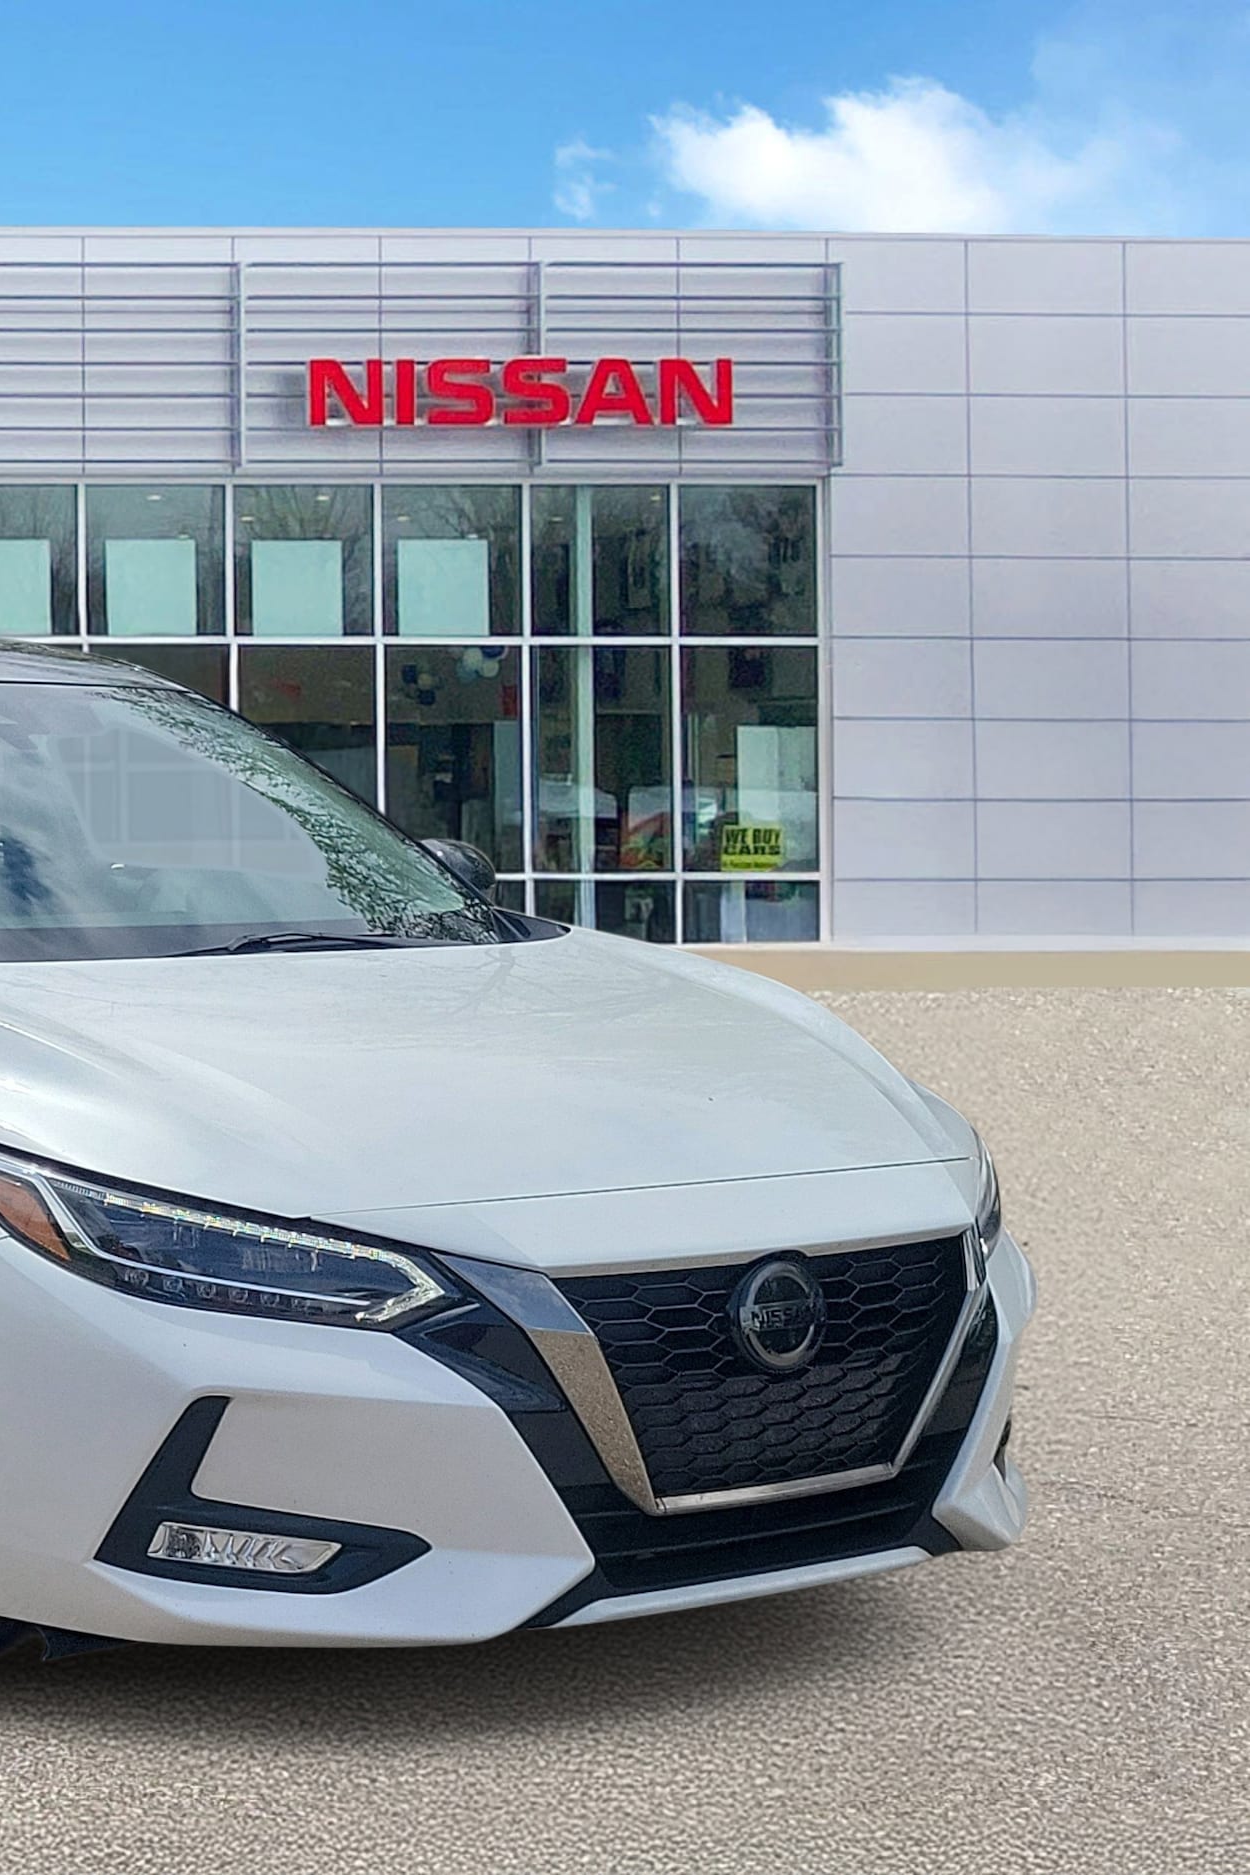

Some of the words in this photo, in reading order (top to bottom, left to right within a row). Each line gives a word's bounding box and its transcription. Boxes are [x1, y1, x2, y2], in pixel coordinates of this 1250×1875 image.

[307, 358, 734, 428] NISSAN
[725, 828, 748, 844] WE
[752, 828, 781, 844] BUY
[724, 844, 781, 855] CARS
